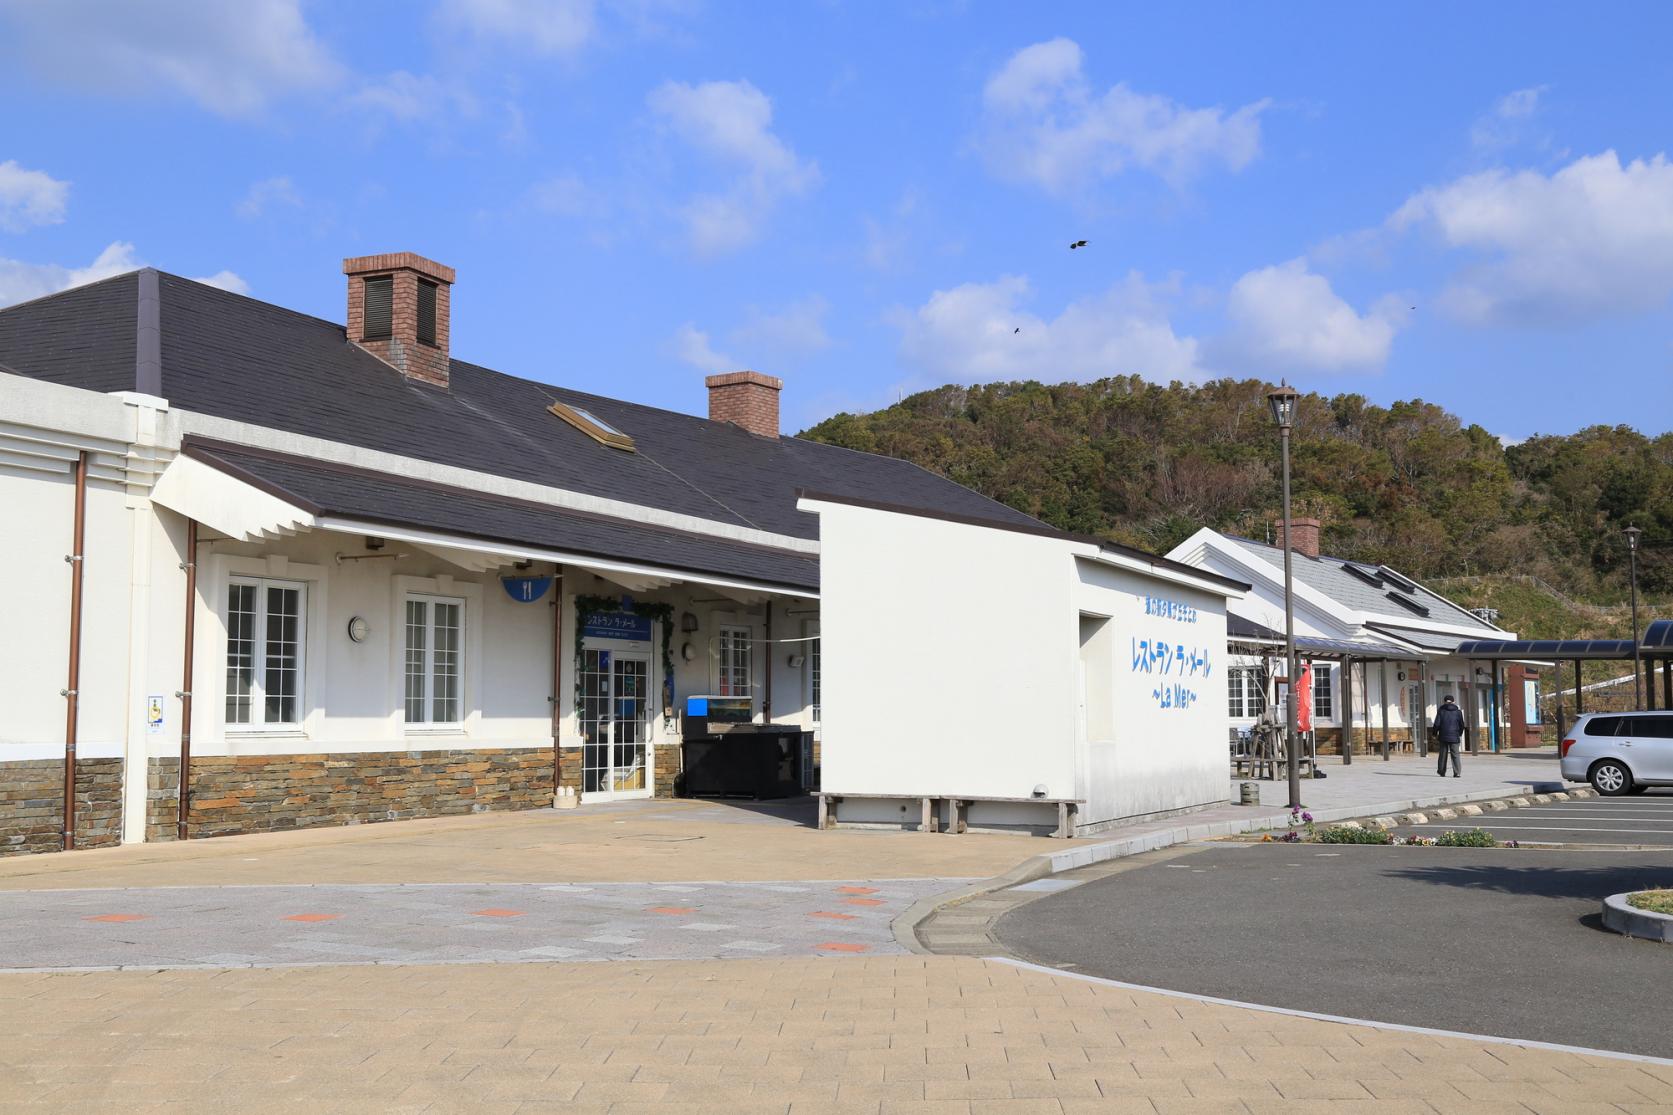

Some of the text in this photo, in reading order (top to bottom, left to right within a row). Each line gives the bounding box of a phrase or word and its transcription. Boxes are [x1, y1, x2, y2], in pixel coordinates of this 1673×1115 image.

[1132, 636, 1173, 675] レストラン
